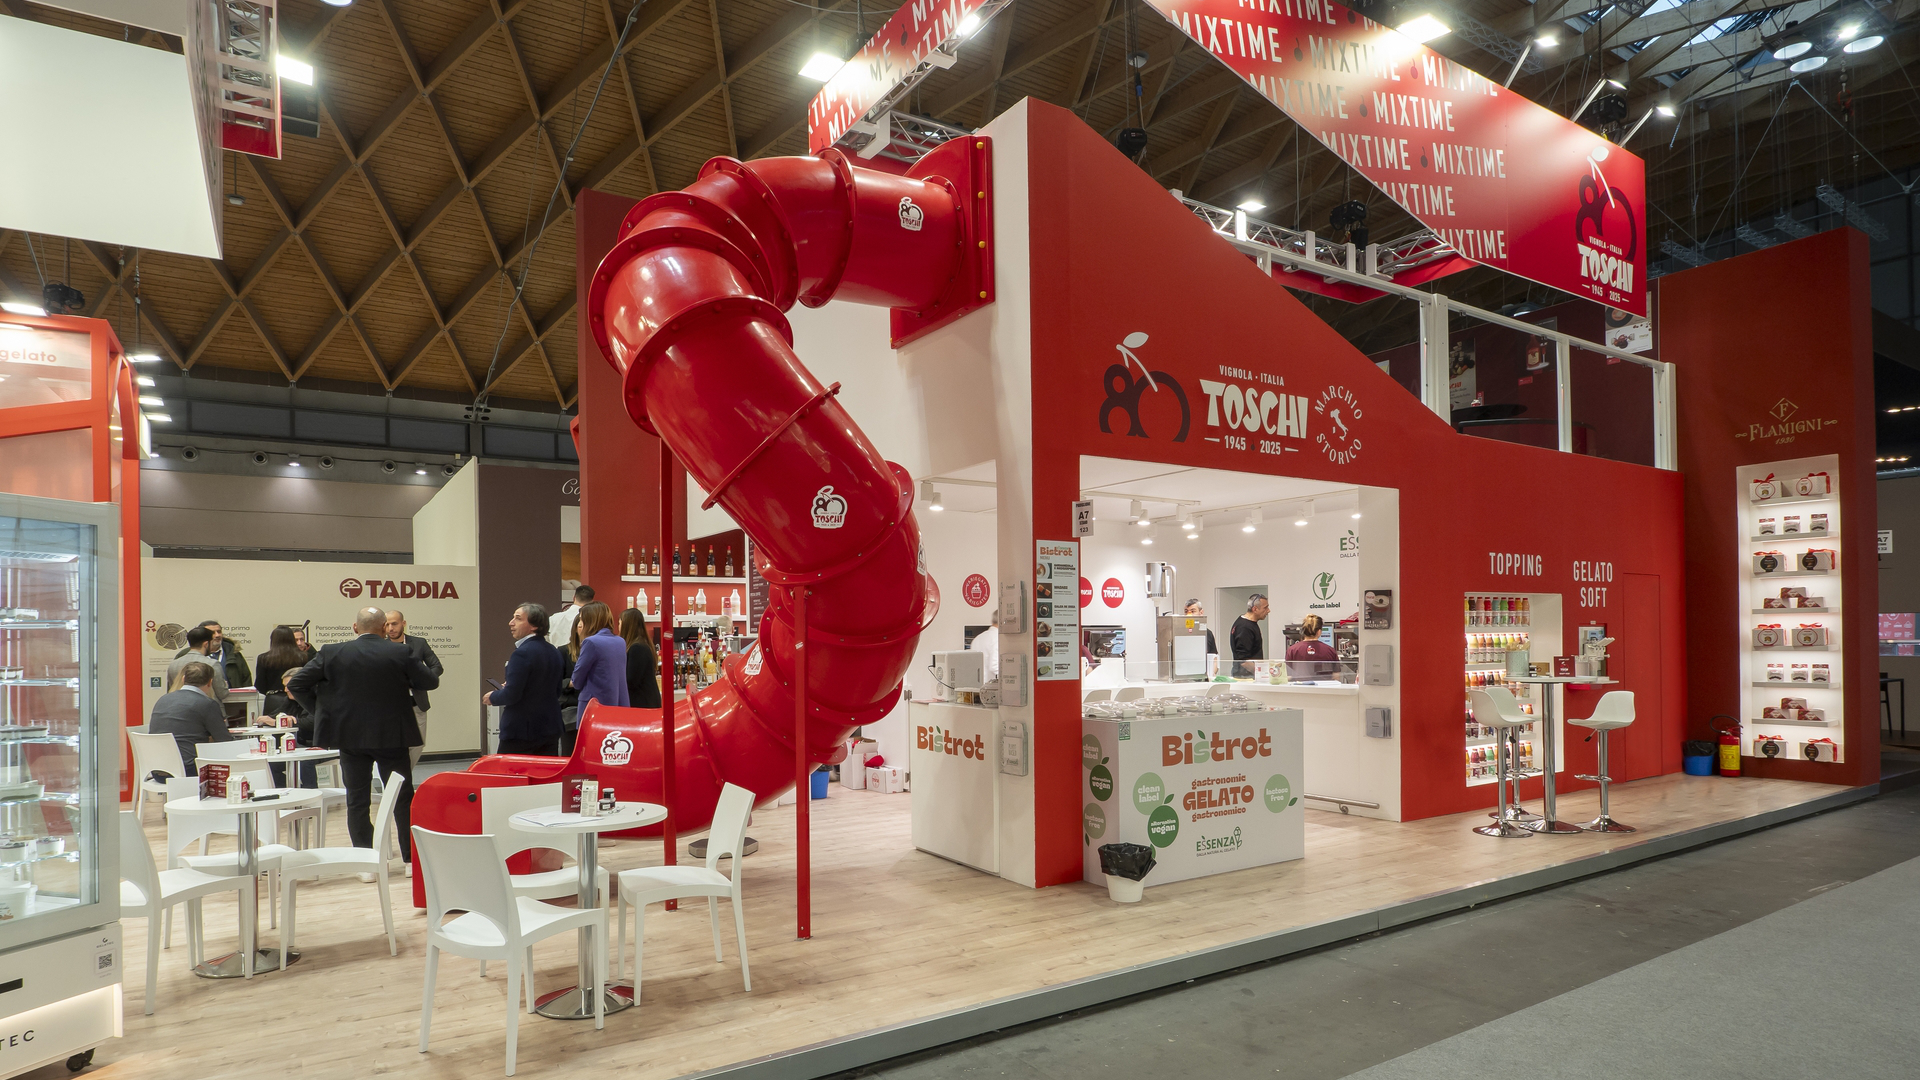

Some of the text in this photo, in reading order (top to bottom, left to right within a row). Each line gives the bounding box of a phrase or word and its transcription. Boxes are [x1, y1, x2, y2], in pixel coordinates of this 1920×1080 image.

[1373, 91, 1455, 131] MIXTIME
[1433, 142, 1506, 178] MIXTIME
[1577, 243, 1634, 294] TOSCHI
[1591, 284, 1621, 303] 1945 2025
[1219, 364, 1285, 386] VIGNOLA ITALIA
[1199, 378, 1309, 439] TOSCHI
[1314, 385, 1363, 421] MARCHIO
[1749, 418, 1822, 442] FLAMIGNI
[1224, 435, 1281, 456] 1945 2025
[1316, 432, 1362, 465] STORICO
[815, 515, 842, 524] TOSCHI
[1078, 511, 1089, 520] A7
[1040, 546, 1073, 557] Bistrot
[1489, 552, 1542, 577] TOPPING
[1573, 560, 1613, 582] GELATO
[365, 580, 459, 599] TADDIA
[1580, 587, 1607, 607] SOFT
[1326, 601, 1340, 609] label
[1092, 781, 1110, 790] vegan
[1137, 784, 1160, 794] clean
[1192, 773, 1246, 790] gastronomic
[1139, 792, 1159, 803] label
[1183, 785, 1254, 811] GELATO
[1192, 806, 1246, 822] gastronomico
[1151, 824, 1175, 835] vegan
